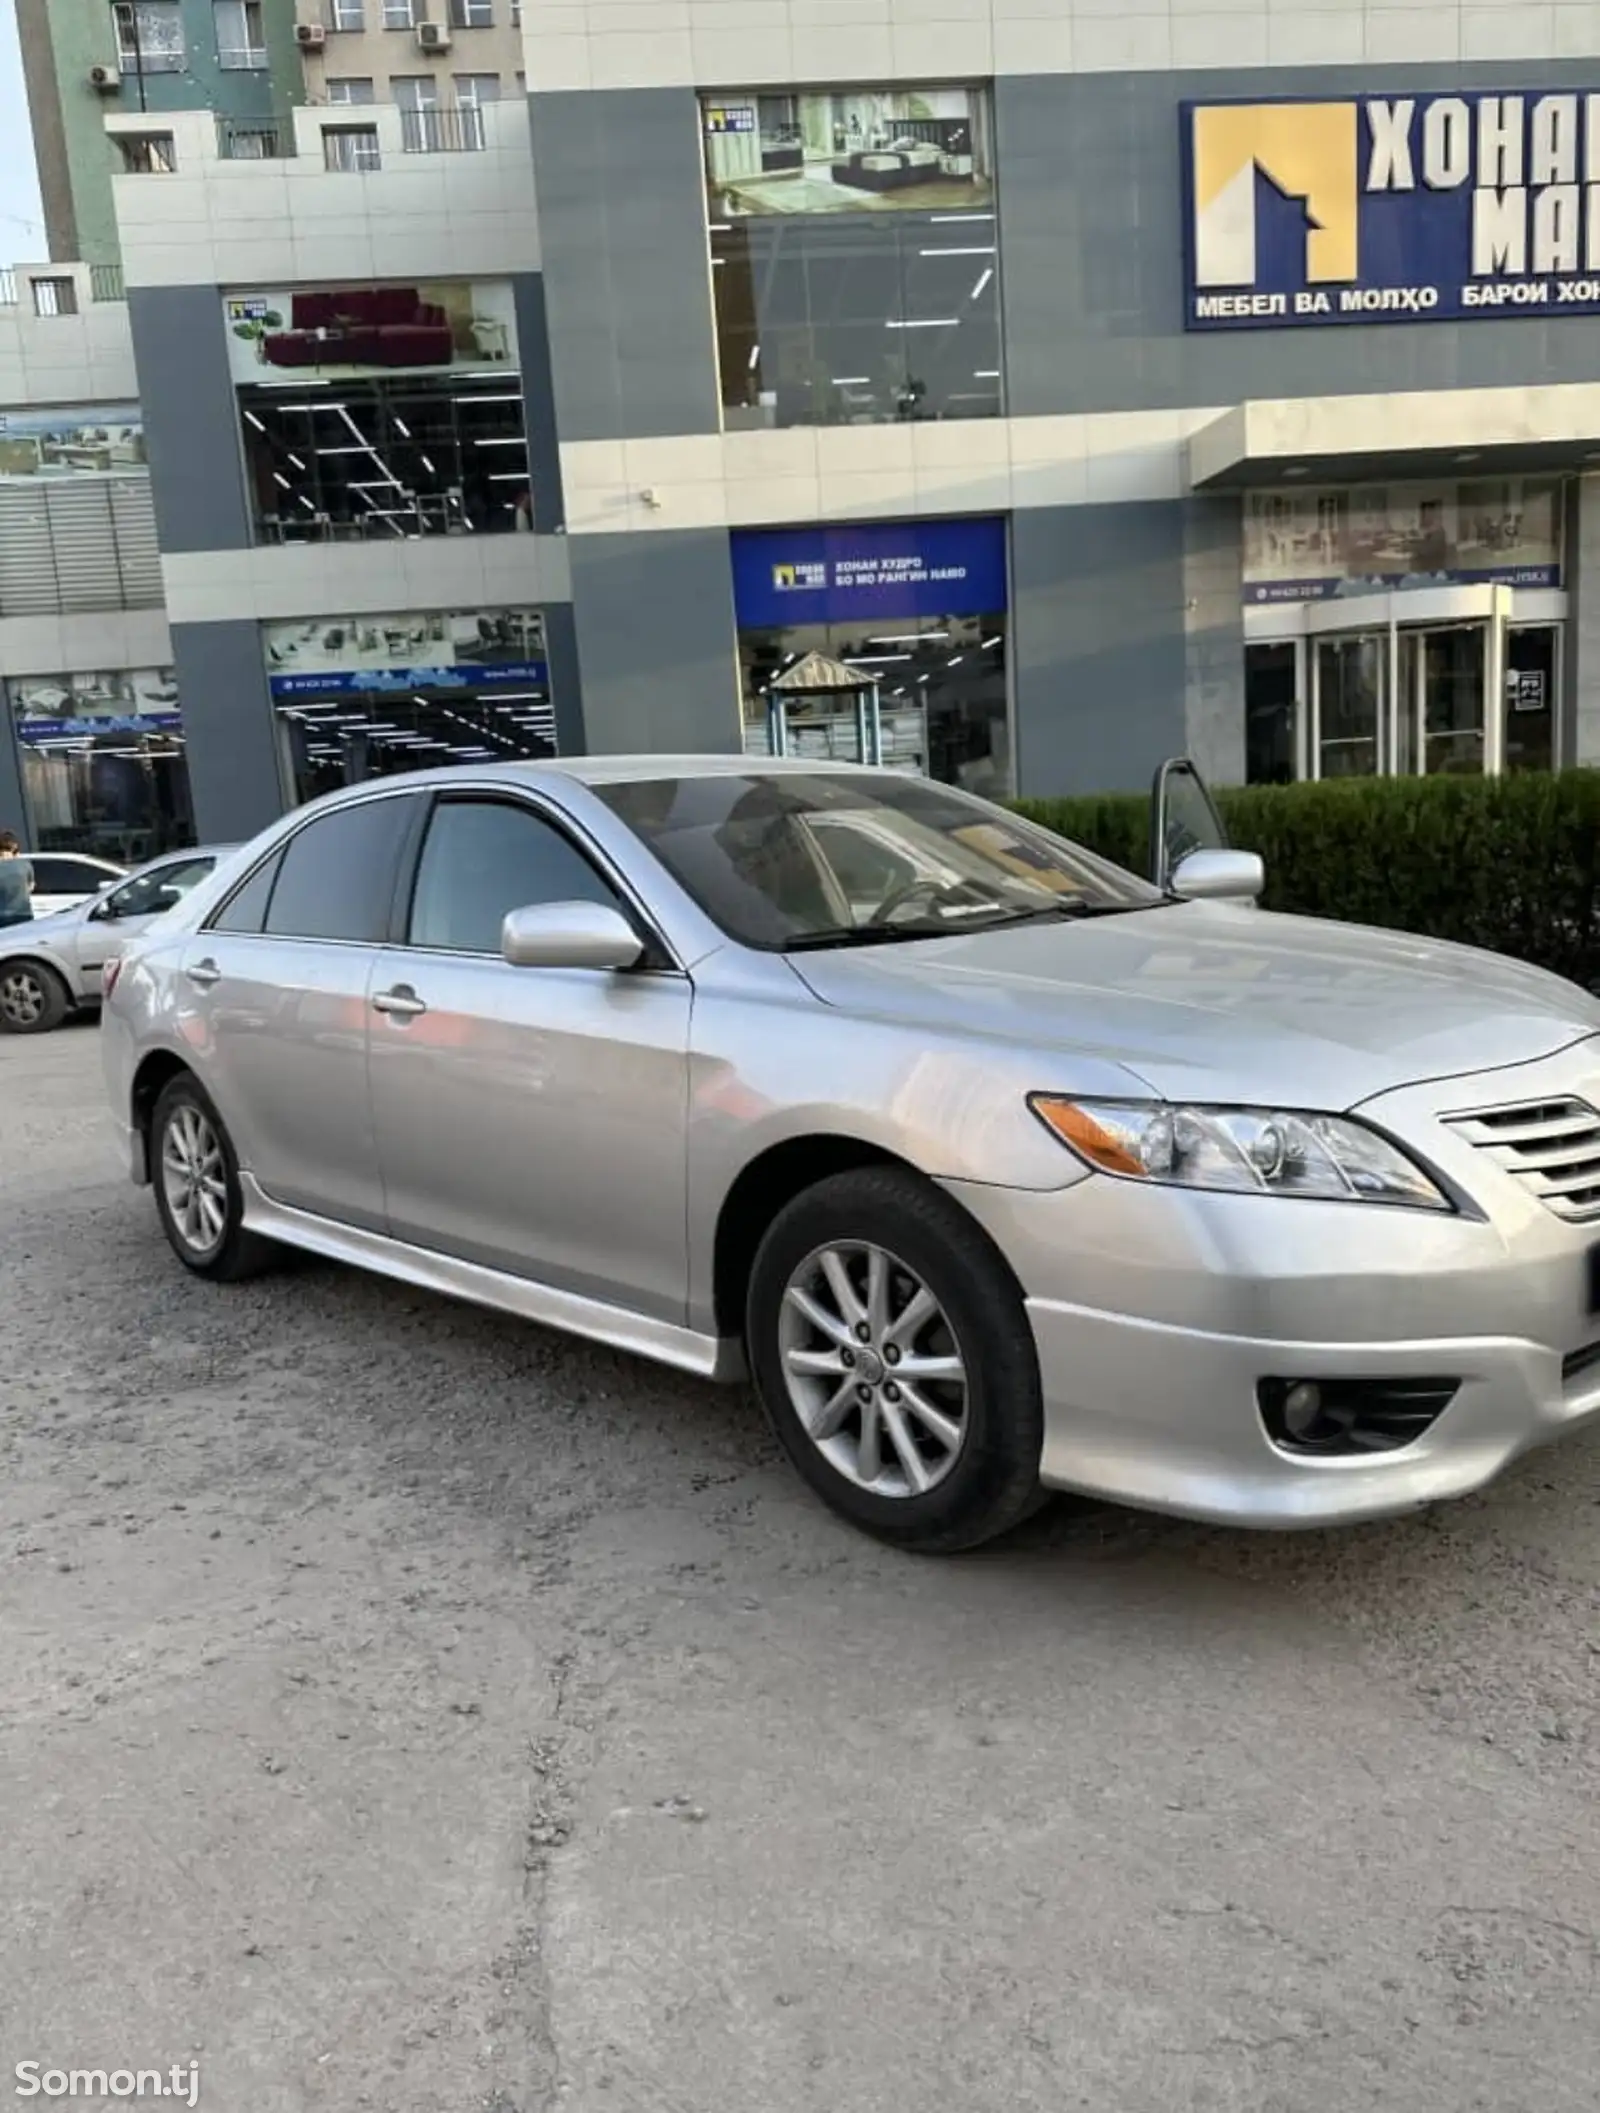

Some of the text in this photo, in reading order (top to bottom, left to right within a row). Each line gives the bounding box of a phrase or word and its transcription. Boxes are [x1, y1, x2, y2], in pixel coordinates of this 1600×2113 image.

[1196, 294, 1286, 318] МЕБЕЛ
[1295, 292, 1331, 314] ВА
[1340, 286, 1438, 313] МОЛҲО
[1461, 282, 1548, 306] БАРОИ
